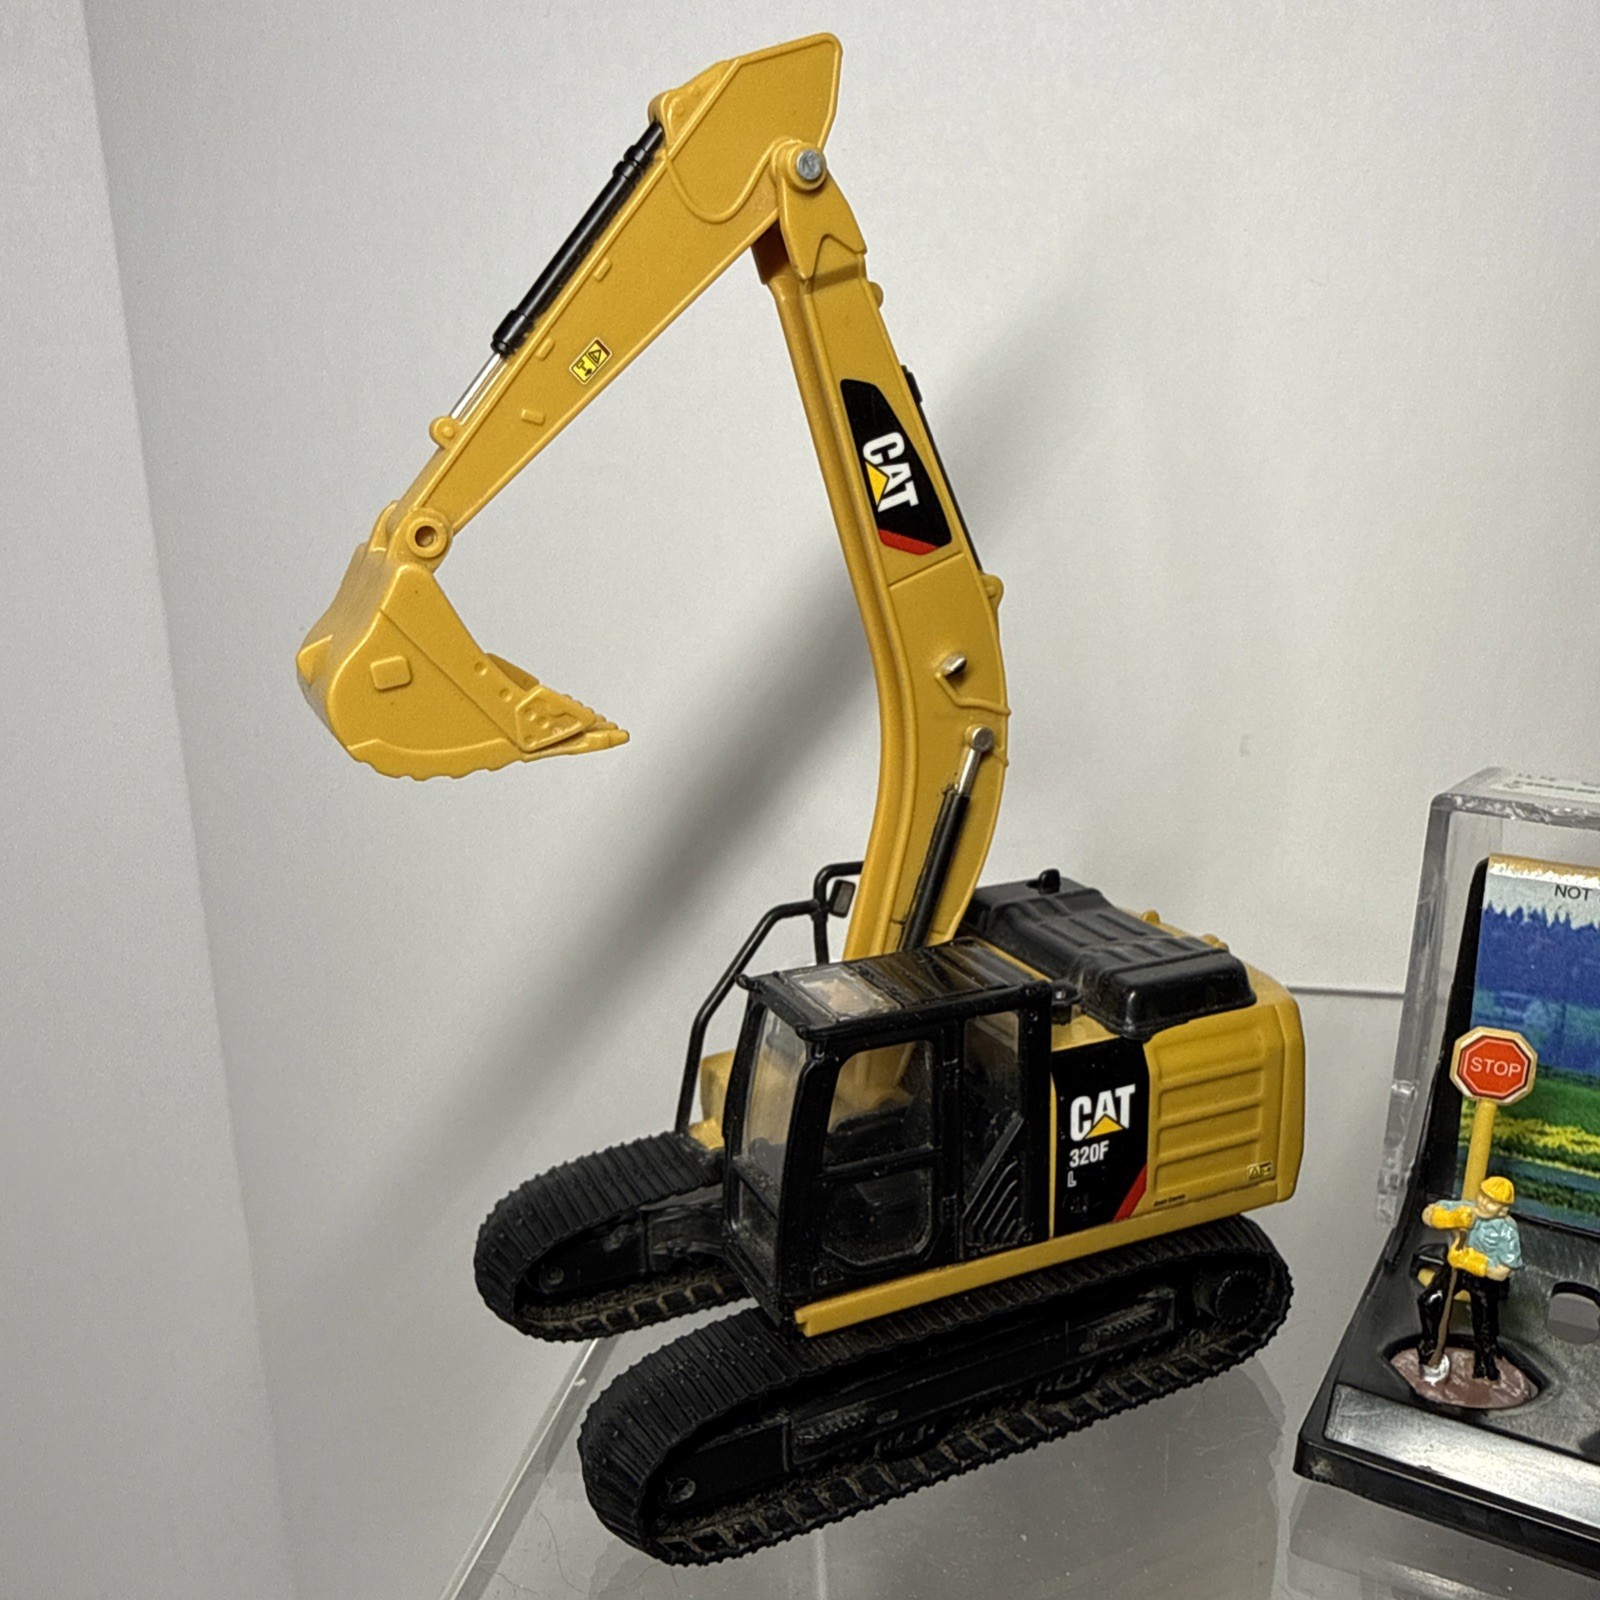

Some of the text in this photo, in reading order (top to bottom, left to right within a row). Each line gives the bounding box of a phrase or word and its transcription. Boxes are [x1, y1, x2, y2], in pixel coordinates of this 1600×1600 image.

[862, 431, 920, 513] CAT
[1554, 884, 1594, 901] NOT
[1470, 1056, 1522, 1077] STOP
[1070, 1083, 1136, 1142] CAT
[1069, 1140, 1110, 1168] 320F
